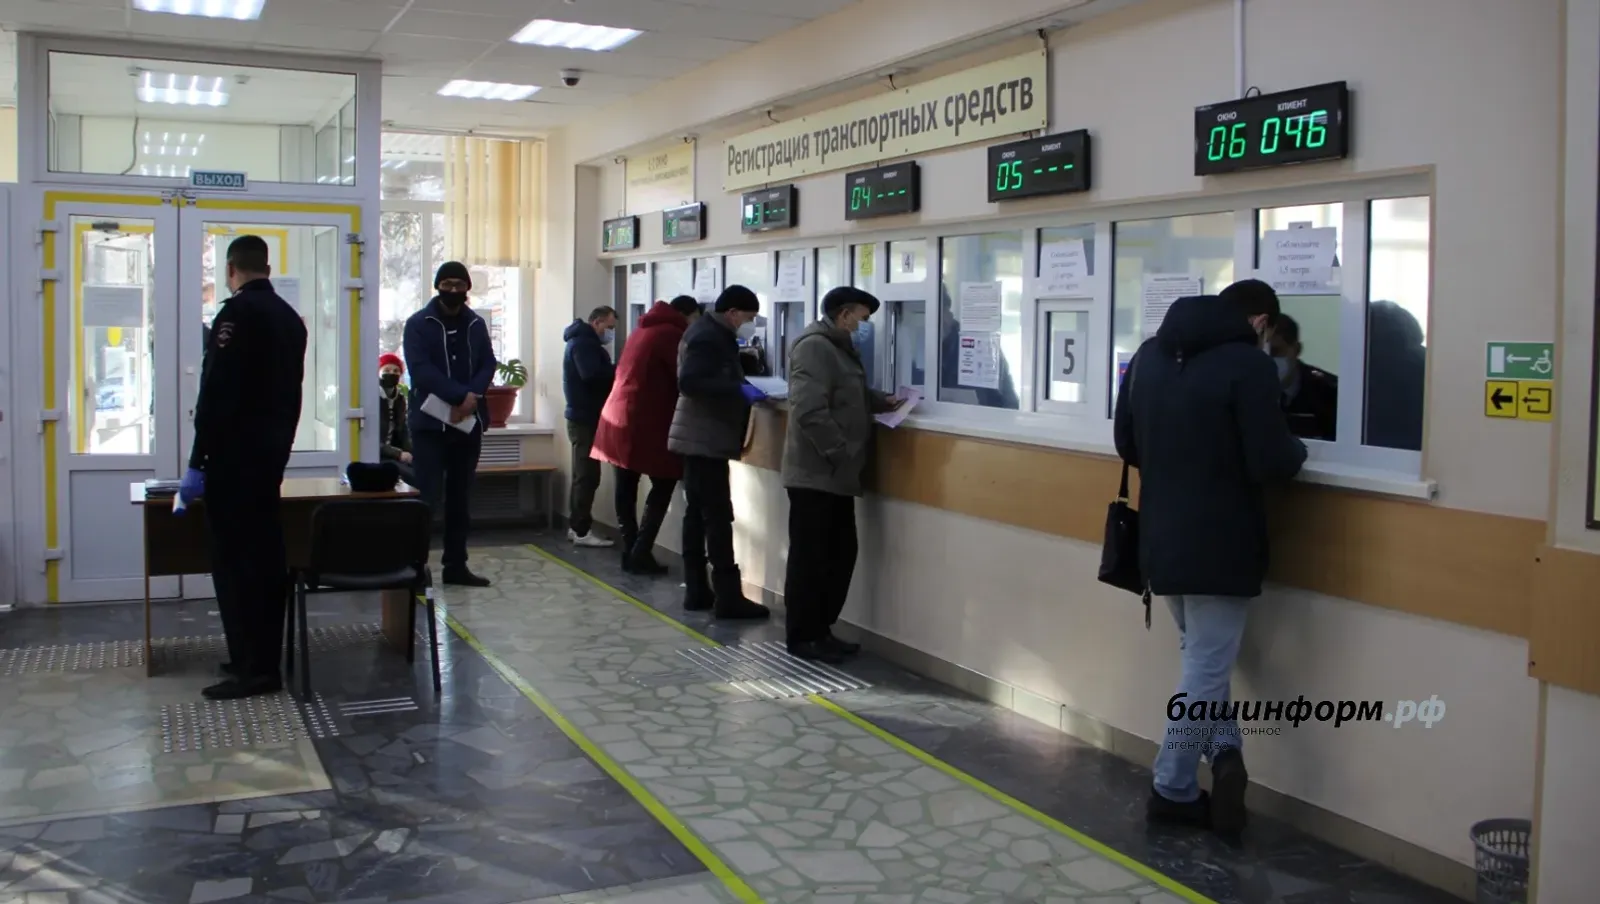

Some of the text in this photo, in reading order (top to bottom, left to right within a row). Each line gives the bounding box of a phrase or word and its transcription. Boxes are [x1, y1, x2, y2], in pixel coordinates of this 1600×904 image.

[1217, 98, 1308, 122] ОКНО КЛИЕНТ
[728, 76, 1034, 176] Регистрация транспортных средств
[1208, 109, 1327, 161] 06 046
[195, 174, 242, 186] ВЫХОД
[996, 160, 1022, 191] 05
[851, 186, 871, 211] 04
[1062, 338, 1075, 375] 5
